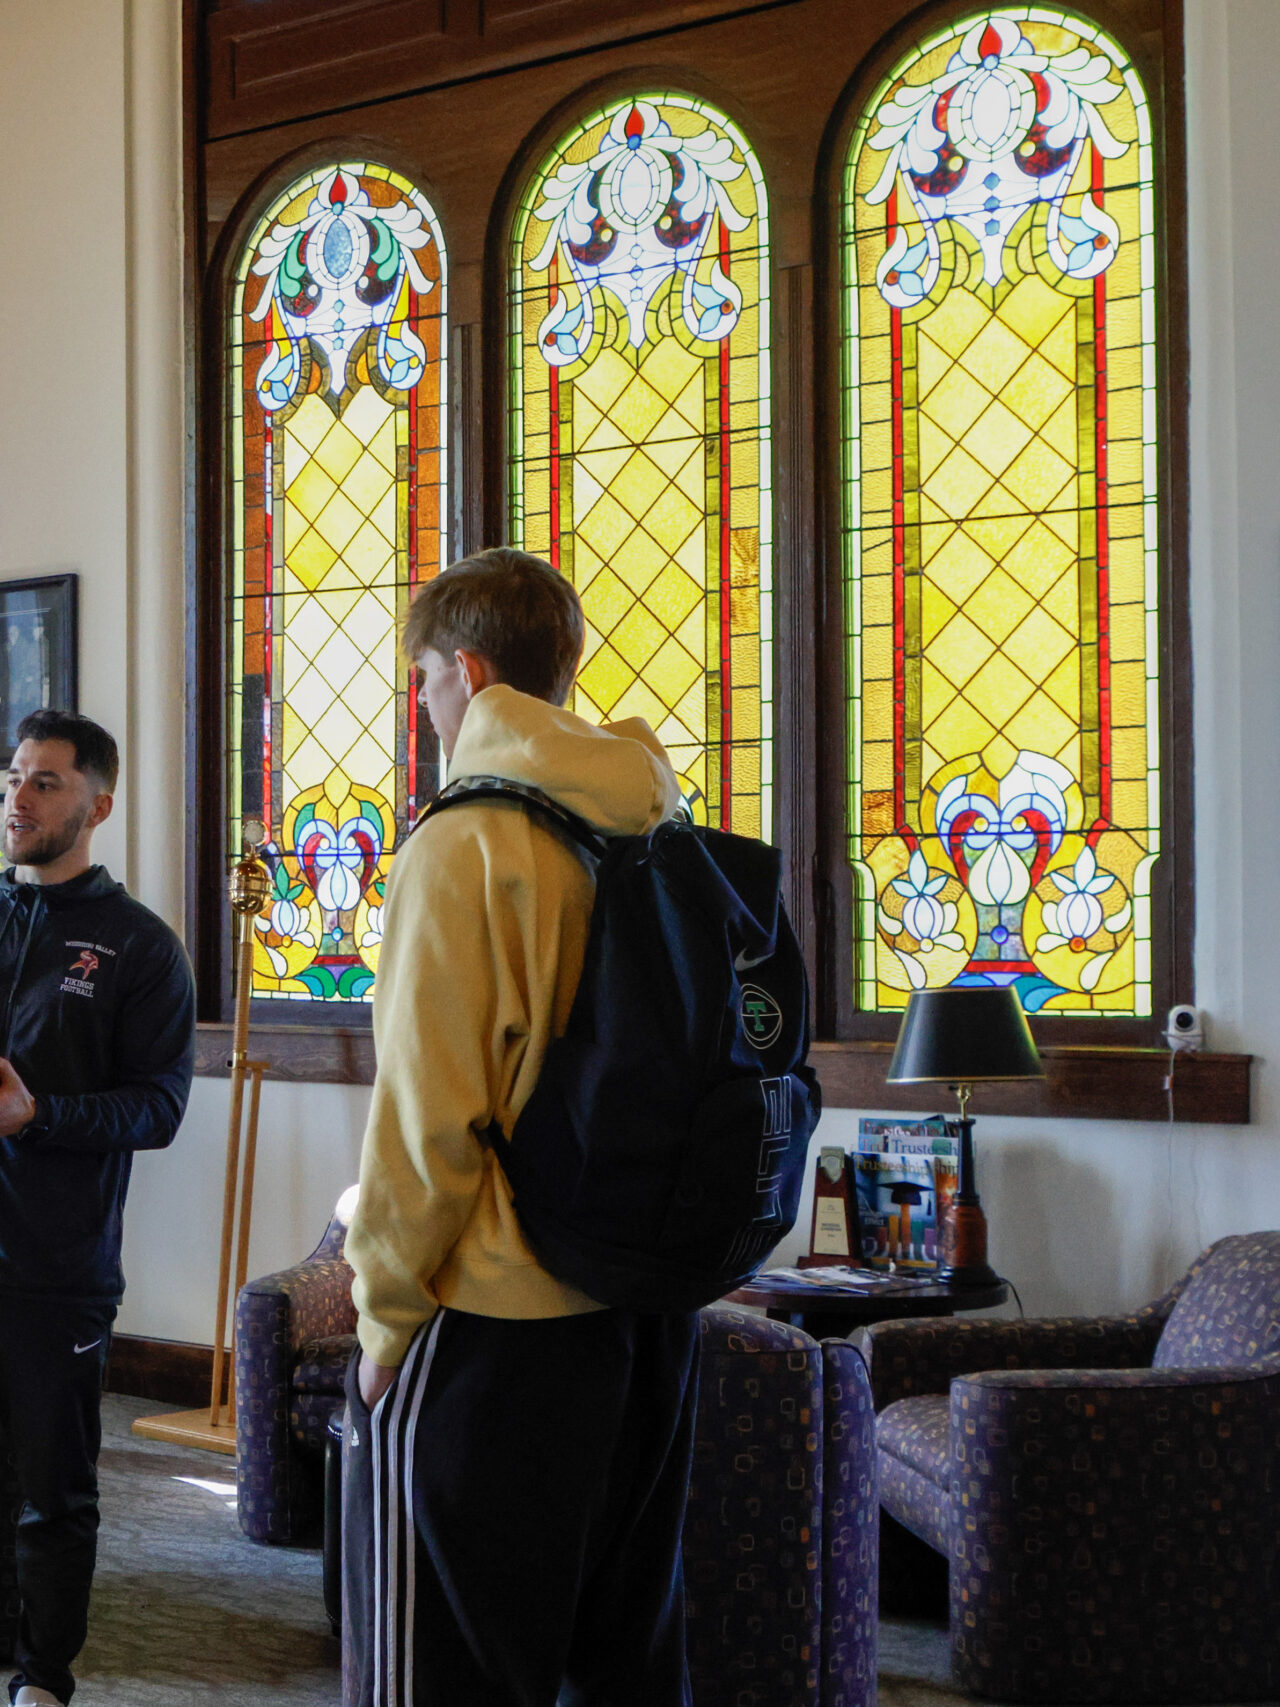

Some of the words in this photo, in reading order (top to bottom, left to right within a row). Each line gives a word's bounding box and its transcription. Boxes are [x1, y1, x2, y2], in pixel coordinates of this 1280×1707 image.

[95, 944, 117, 957] VALLEY
[64, 976, 95, 990] VIKINGS
[60, 984, 94, 998] FOOTBALL
[746, 1001, 766, 1032] T
